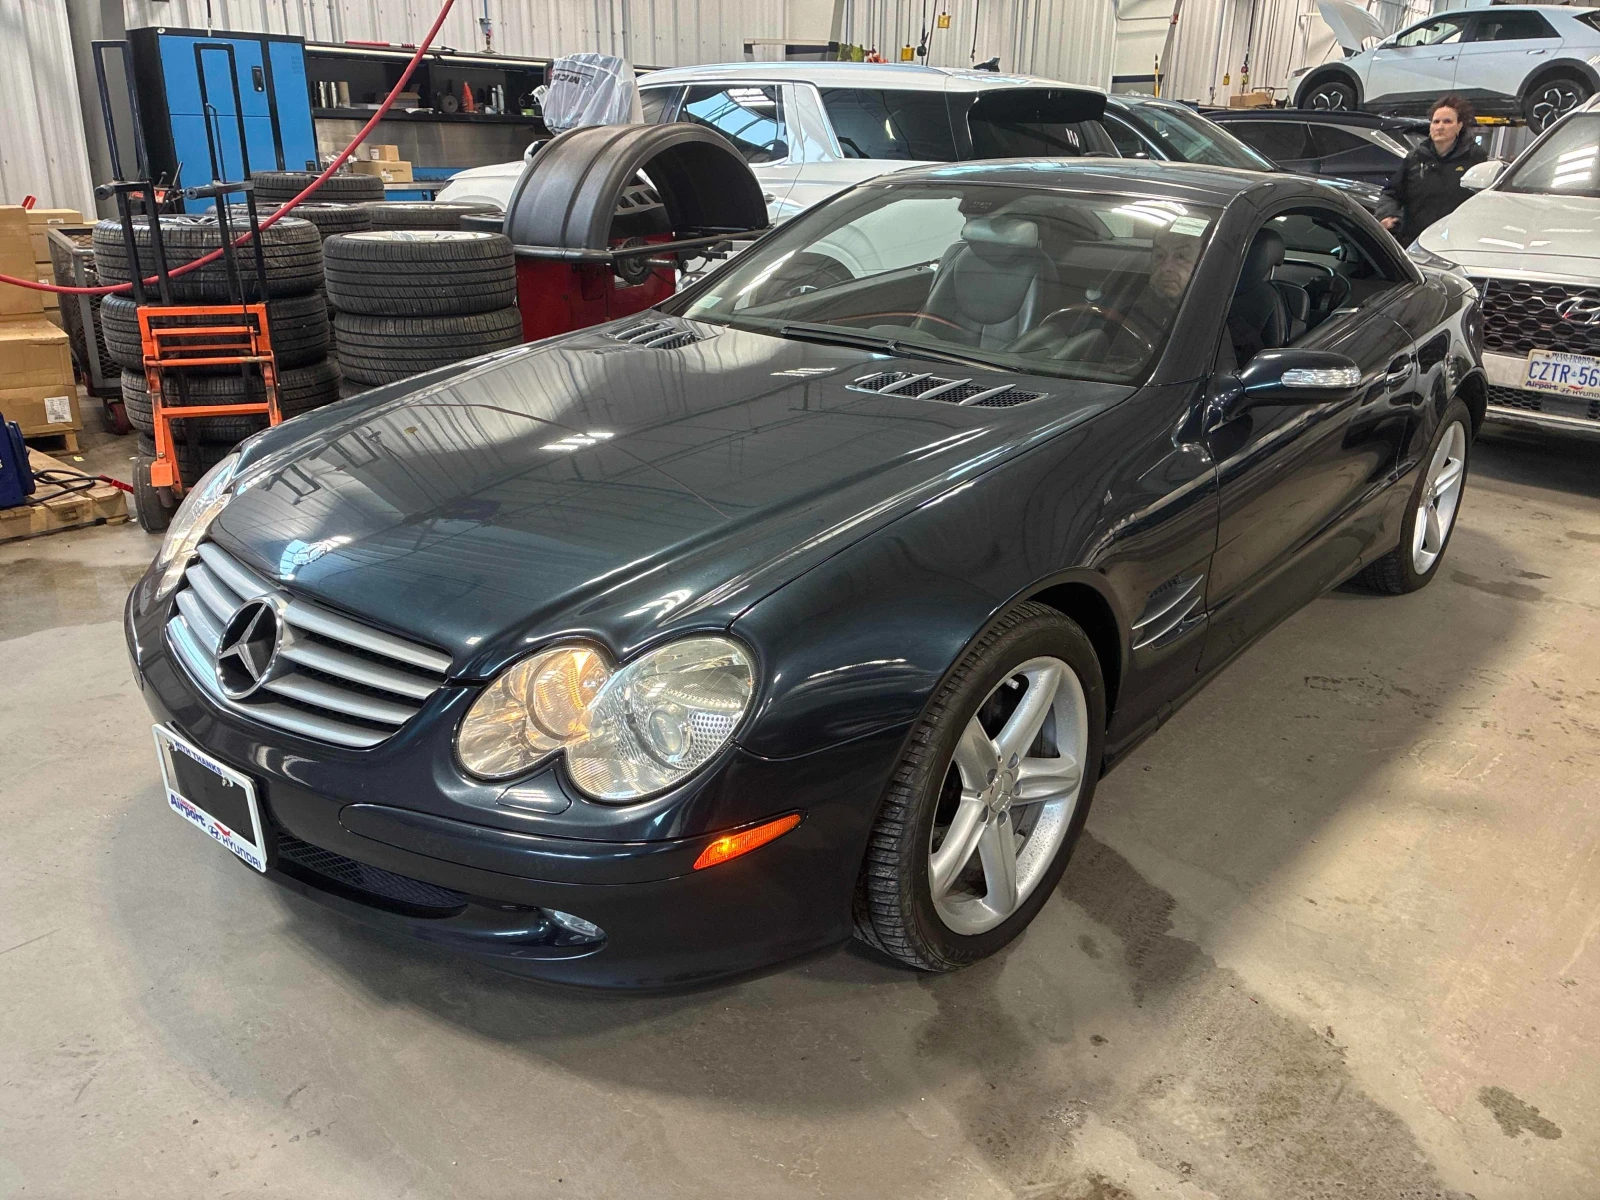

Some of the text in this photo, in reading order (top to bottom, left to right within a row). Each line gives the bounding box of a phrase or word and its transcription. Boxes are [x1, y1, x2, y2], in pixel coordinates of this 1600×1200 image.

[1525, 380, 1558, 390] Airport
[1572, 390, 1600, 398] HYUND
[1528, 361, 1600, 387] CZTR 56
[175, 739, 223, 777] WITH THANKS
[170, 793, 206, 827] Airport
[222, 835, 262, 870] HYUNDAI
